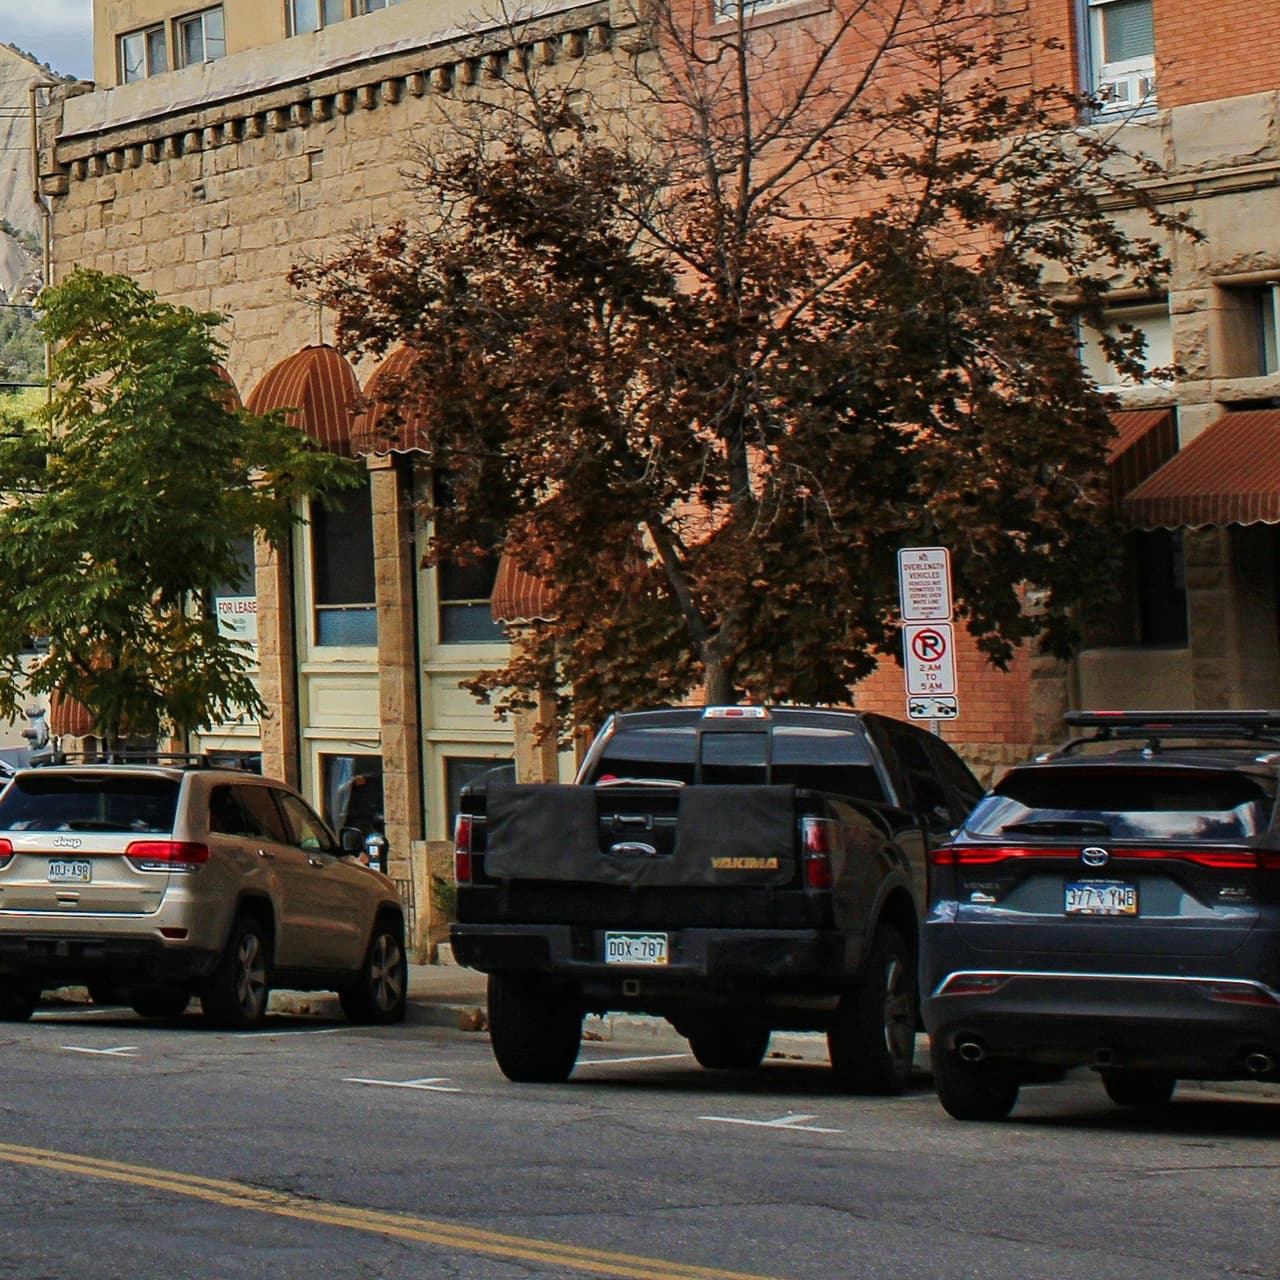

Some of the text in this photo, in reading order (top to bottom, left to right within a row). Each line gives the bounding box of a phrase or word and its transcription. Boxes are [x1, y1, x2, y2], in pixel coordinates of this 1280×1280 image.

[908, 572, 941, 580] VEHICLES
[218, 601, 258, 614] FOR LEASE
[925, 673, 937, 681] TO
[928, 682, 942, 690] AM
[53, 837, 82, 848] Jeep
[710, 856, 780, 870] YAKIMA
